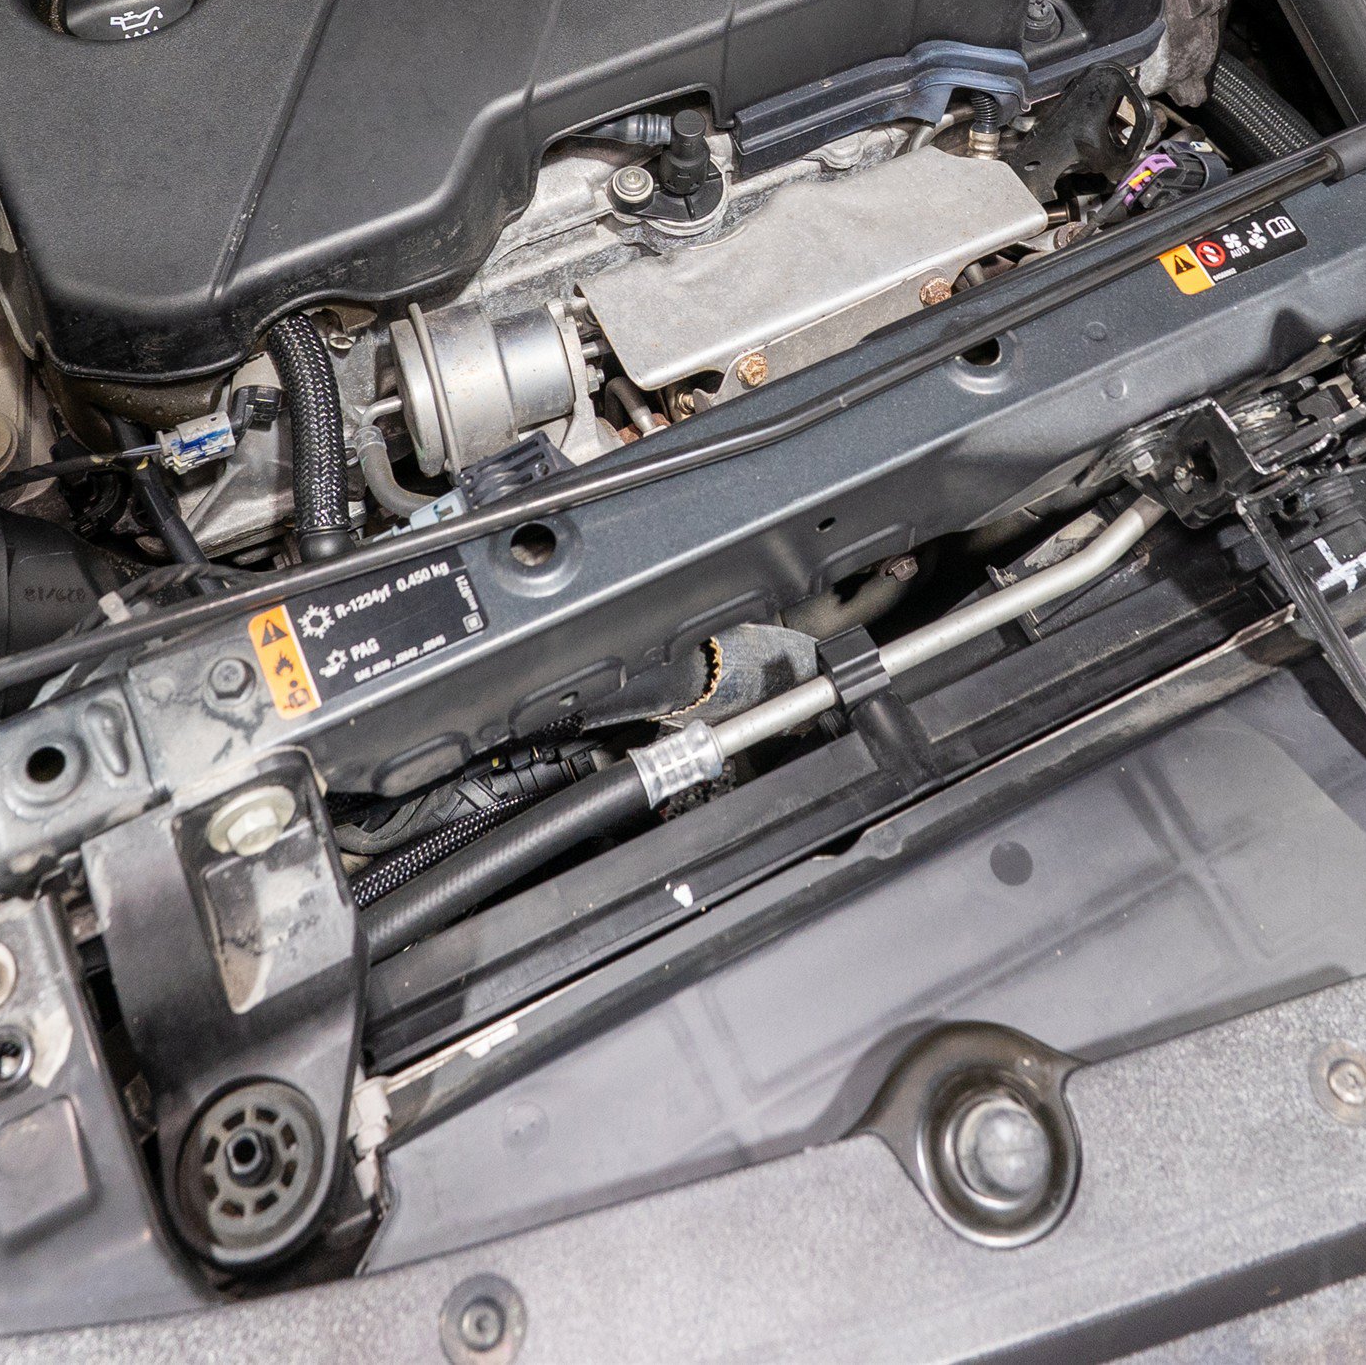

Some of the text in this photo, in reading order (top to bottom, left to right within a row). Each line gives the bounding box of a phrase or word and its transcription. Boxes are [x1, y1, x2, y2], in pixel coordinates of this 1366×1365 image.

[1230, 245, 1250, 259] AUTO
[334, 561, 450, 619] R-1234yf 0.450 kg
[350, 637, 380, 662] PAG
